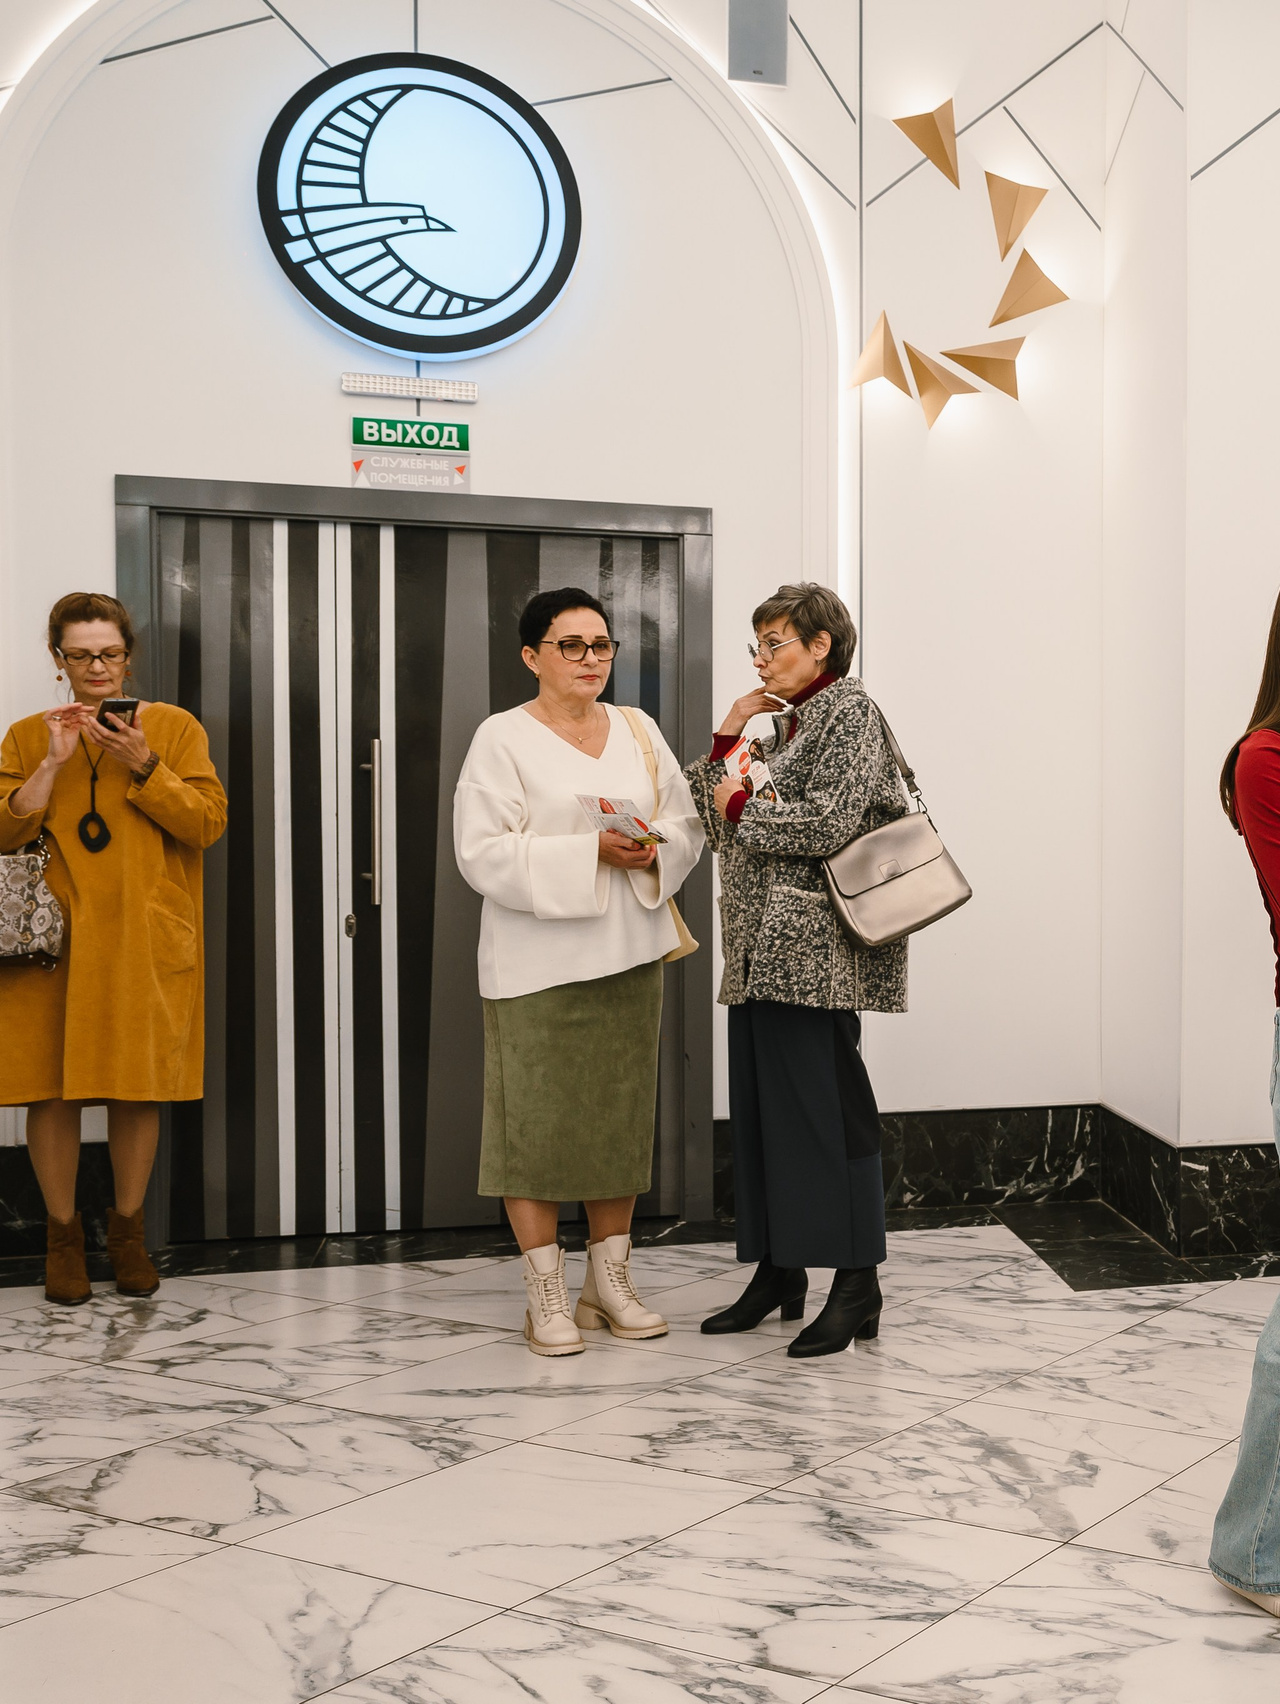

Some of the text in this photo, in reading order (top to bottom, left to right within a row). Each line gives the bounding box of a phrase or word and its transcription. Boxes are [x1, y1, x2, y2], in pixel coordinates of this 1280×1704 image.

[363, 421, 460, 448] ВЫХОД
[370, 456, 449, 471] СЛУЖЕБНЫЕ
[370, 472, 450, 487] ПОМЕЩЕНИЯ
